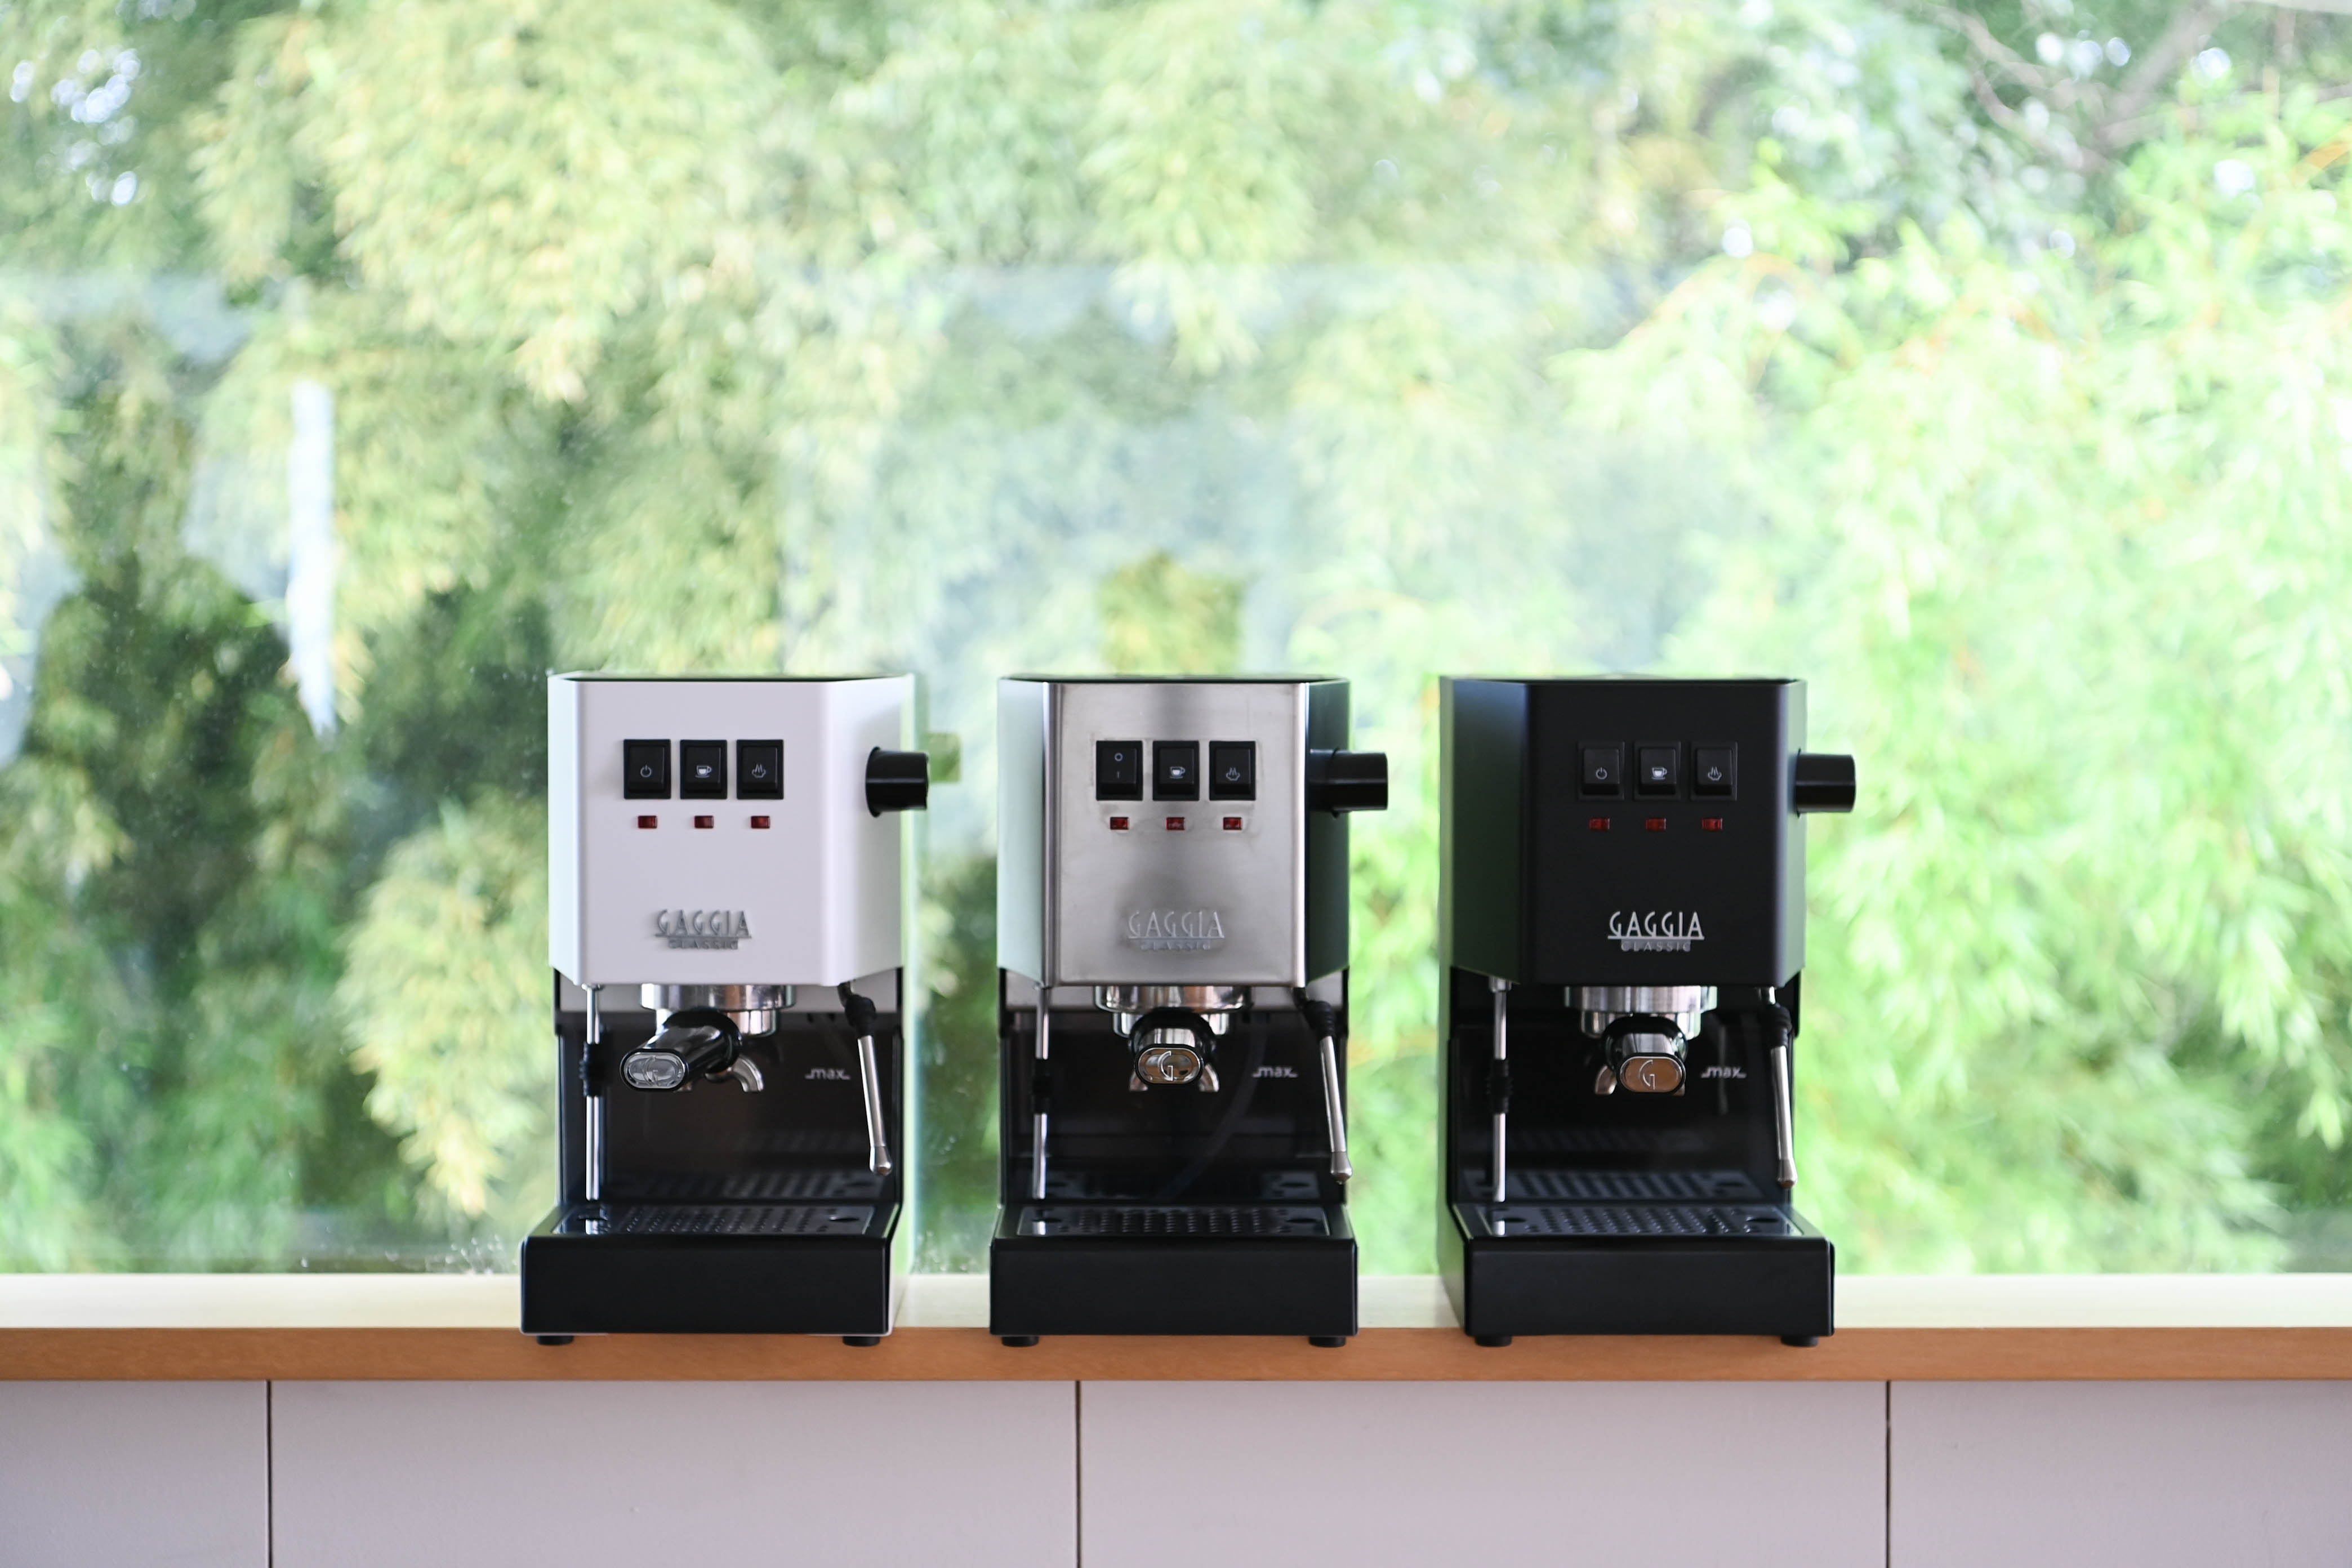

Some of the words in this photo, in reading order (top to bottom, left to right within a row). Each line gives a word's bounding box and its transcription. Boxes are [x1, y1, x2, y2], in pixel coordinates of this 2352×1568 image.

[657, 908, 750, 937] GAGGIA
[1128, 910, 1224, 938] GAGGIA
[1609, 911, 1704, 938] GAGGIA
[1620, 941, 1691, 952] CLASSIC
[809, 1068, 846, 1080] max
[1257, 1066, 1294, 1078] max
[1706, 1066, 1742, 1078] max
